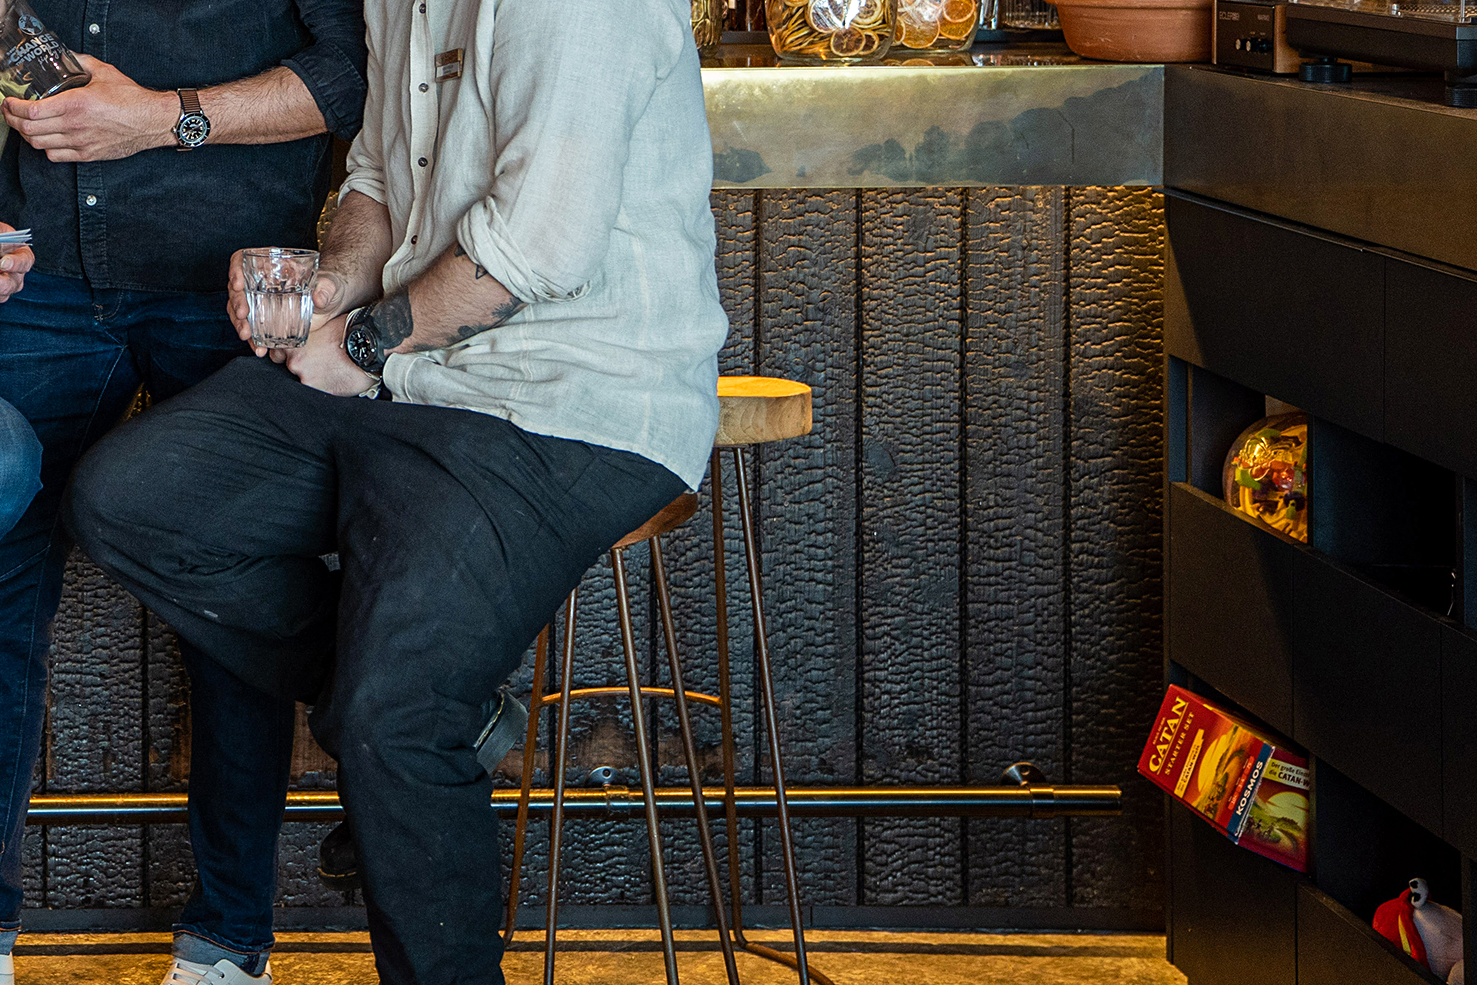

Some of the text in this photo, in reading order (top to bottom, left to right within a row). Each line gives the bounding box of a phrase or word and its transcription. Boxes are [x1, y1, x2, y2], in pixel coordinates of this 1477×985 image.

[10, 33, 55, 63] CHANGE
[24, 41, 60, 63] WORLD
[1148, 696, 1188, 773] CATAN
[1164, 711, 1195, 776] STARTER SET
[1235, 761, 1264, 816] KOSMOS
